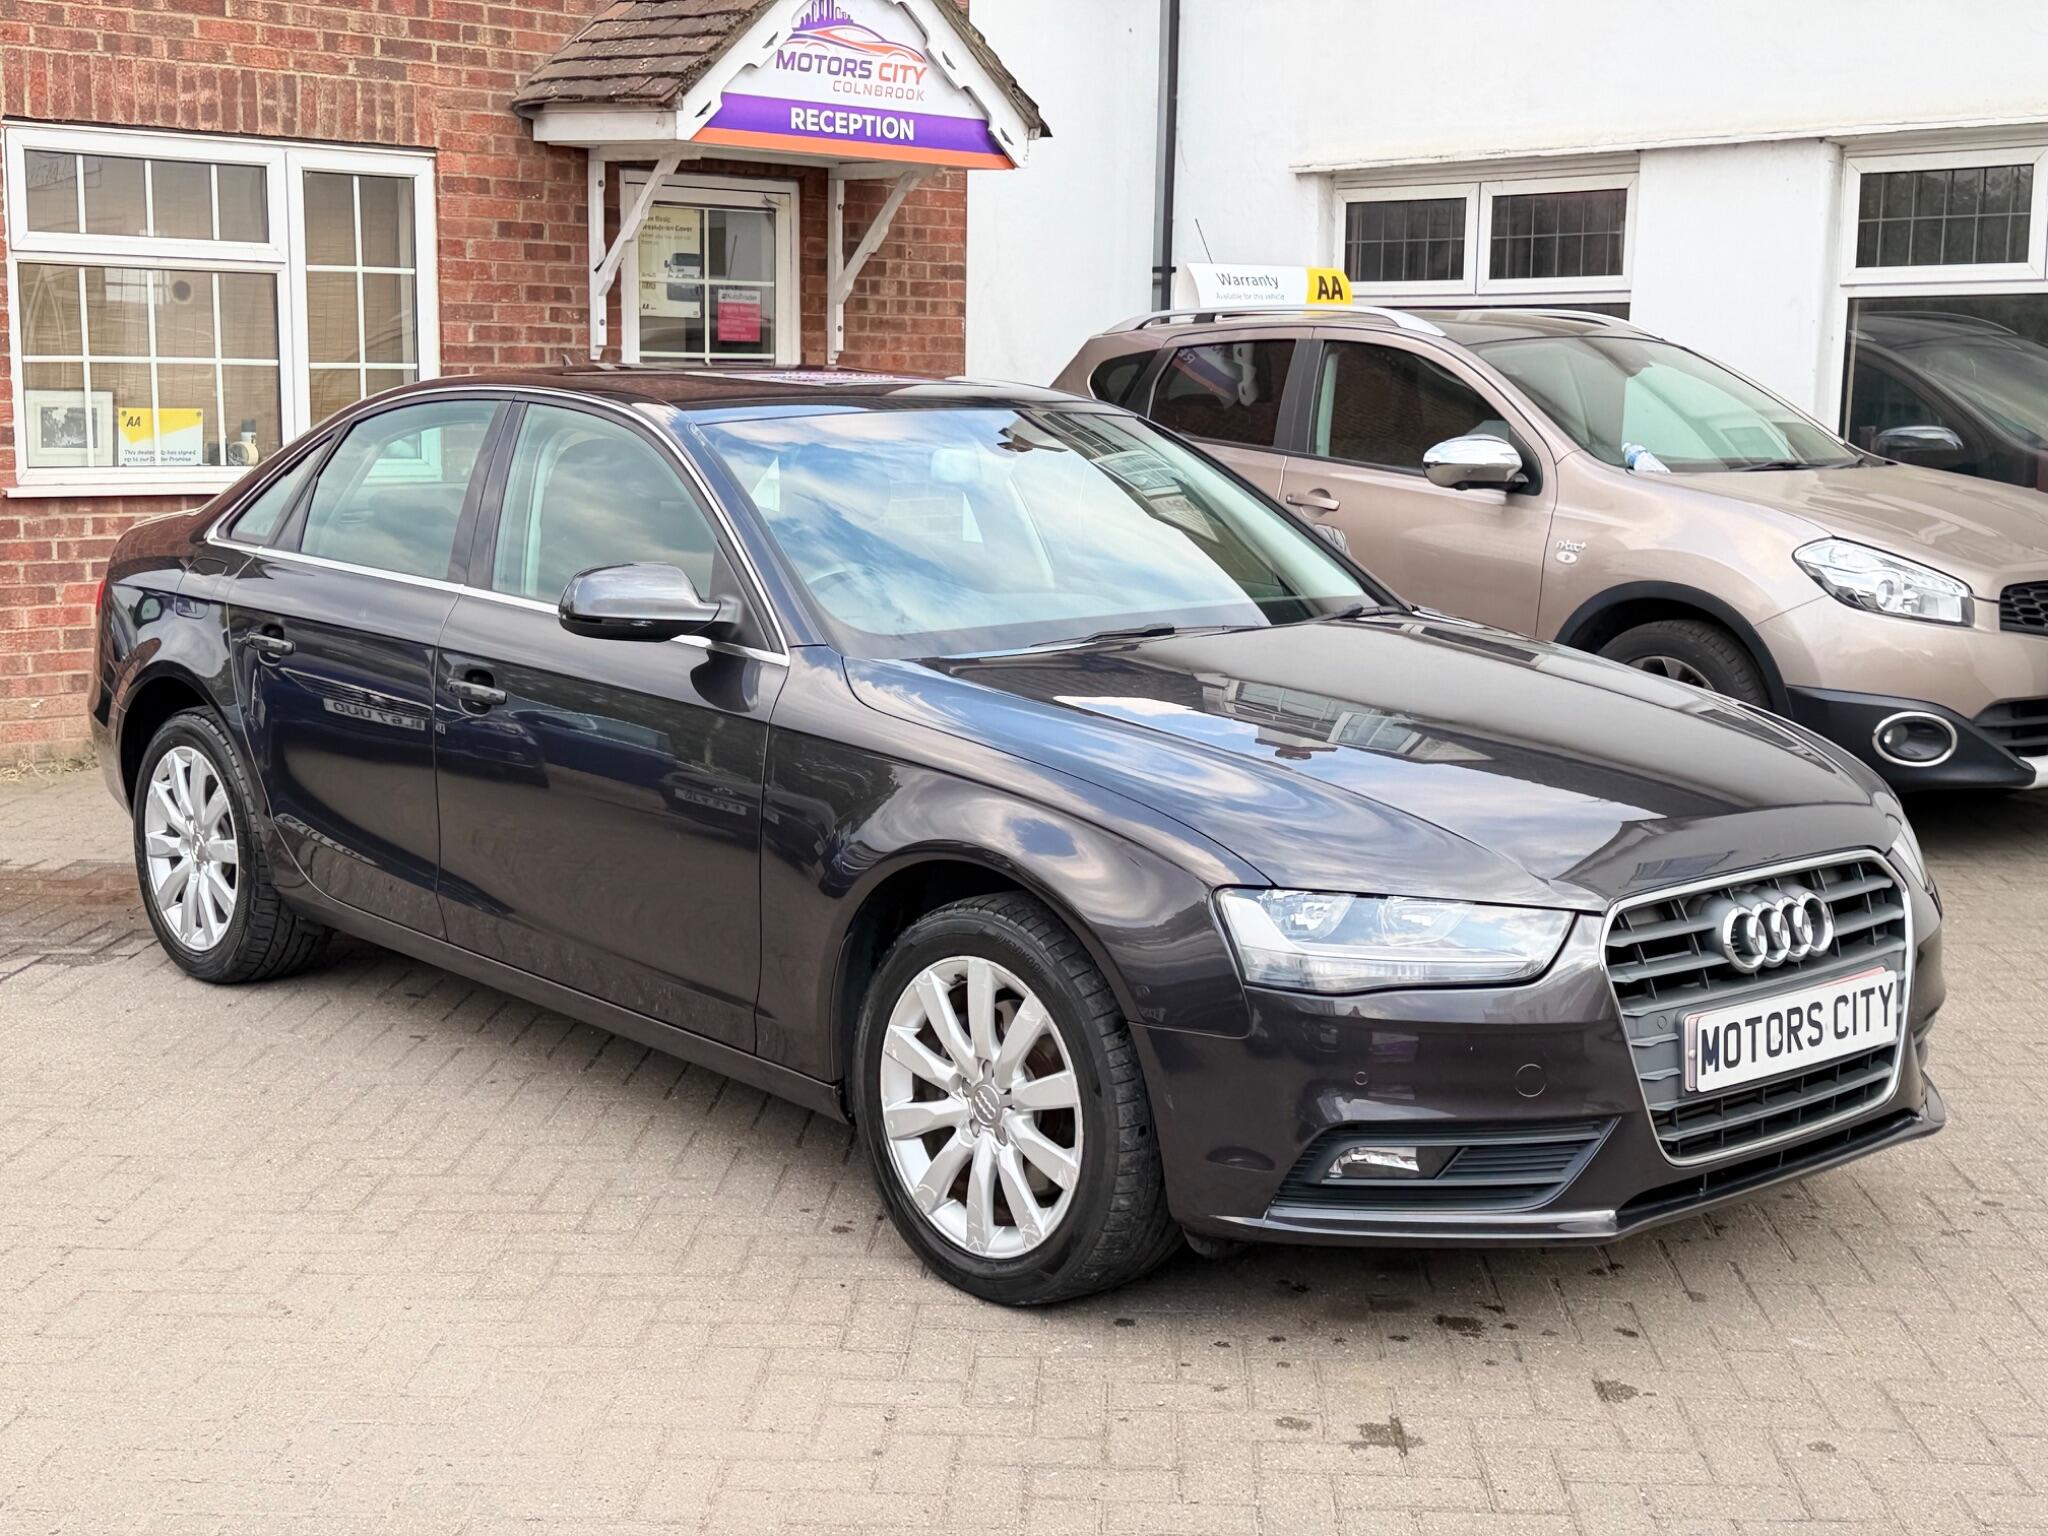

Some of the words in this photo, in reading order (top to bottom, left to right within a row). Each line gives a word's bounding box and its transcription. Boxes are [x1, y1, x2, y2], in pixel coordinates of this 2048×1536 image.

[776, 50, 872, 79] MOTORS
[879, 63, 927, 85] CITY
[833, 80, 925, 101] COLNBROOK
[790, 107, 914, 140] RECEPTION
[1216, 272, 1279, 289] Warranty
[1317, 275, 1344, 300] AA
[126, 416, 141, 427] AA
[1701, 1002, 1824, 1076] MOTORS
[1834, 983, 1894, 1040] CITY
